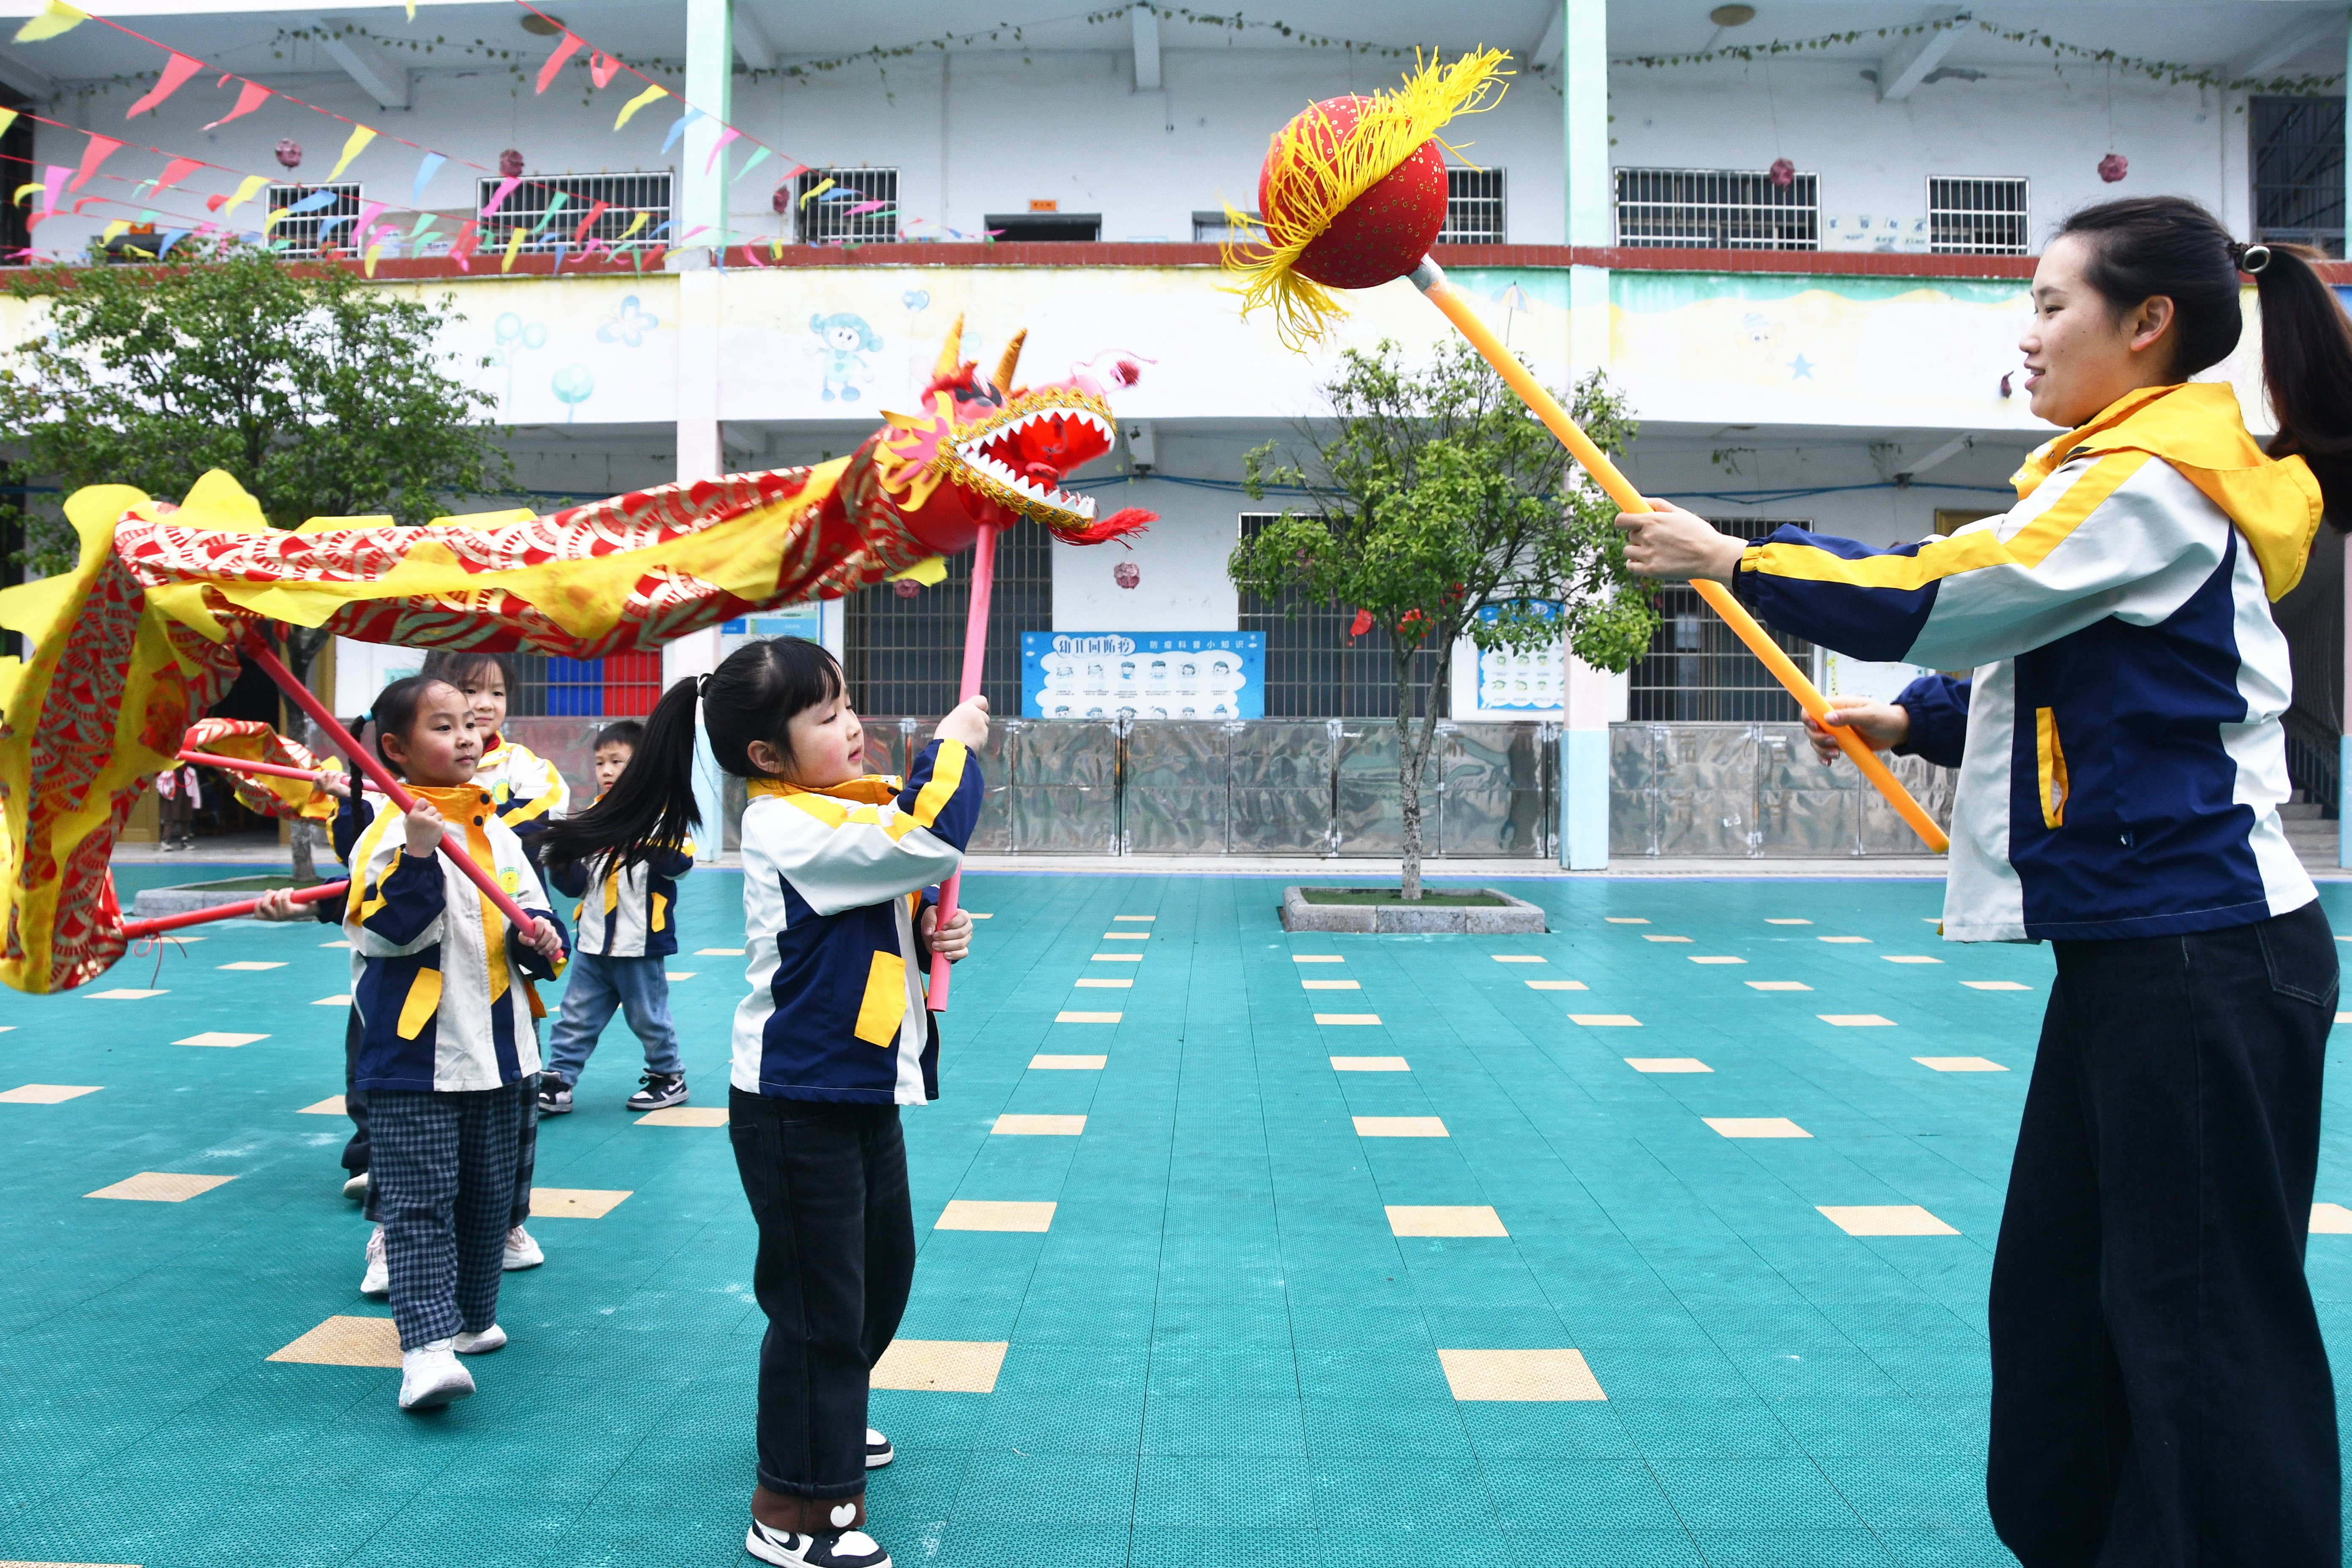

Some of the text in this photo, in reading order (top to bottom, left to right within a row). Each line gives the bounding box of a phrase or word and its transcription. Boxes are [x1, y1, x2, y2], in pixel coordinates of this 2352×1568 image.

[1059, 638, 1130, 653] 幼儿园防护
[1149, 640, 1244, 649] 防疫科普小知识
